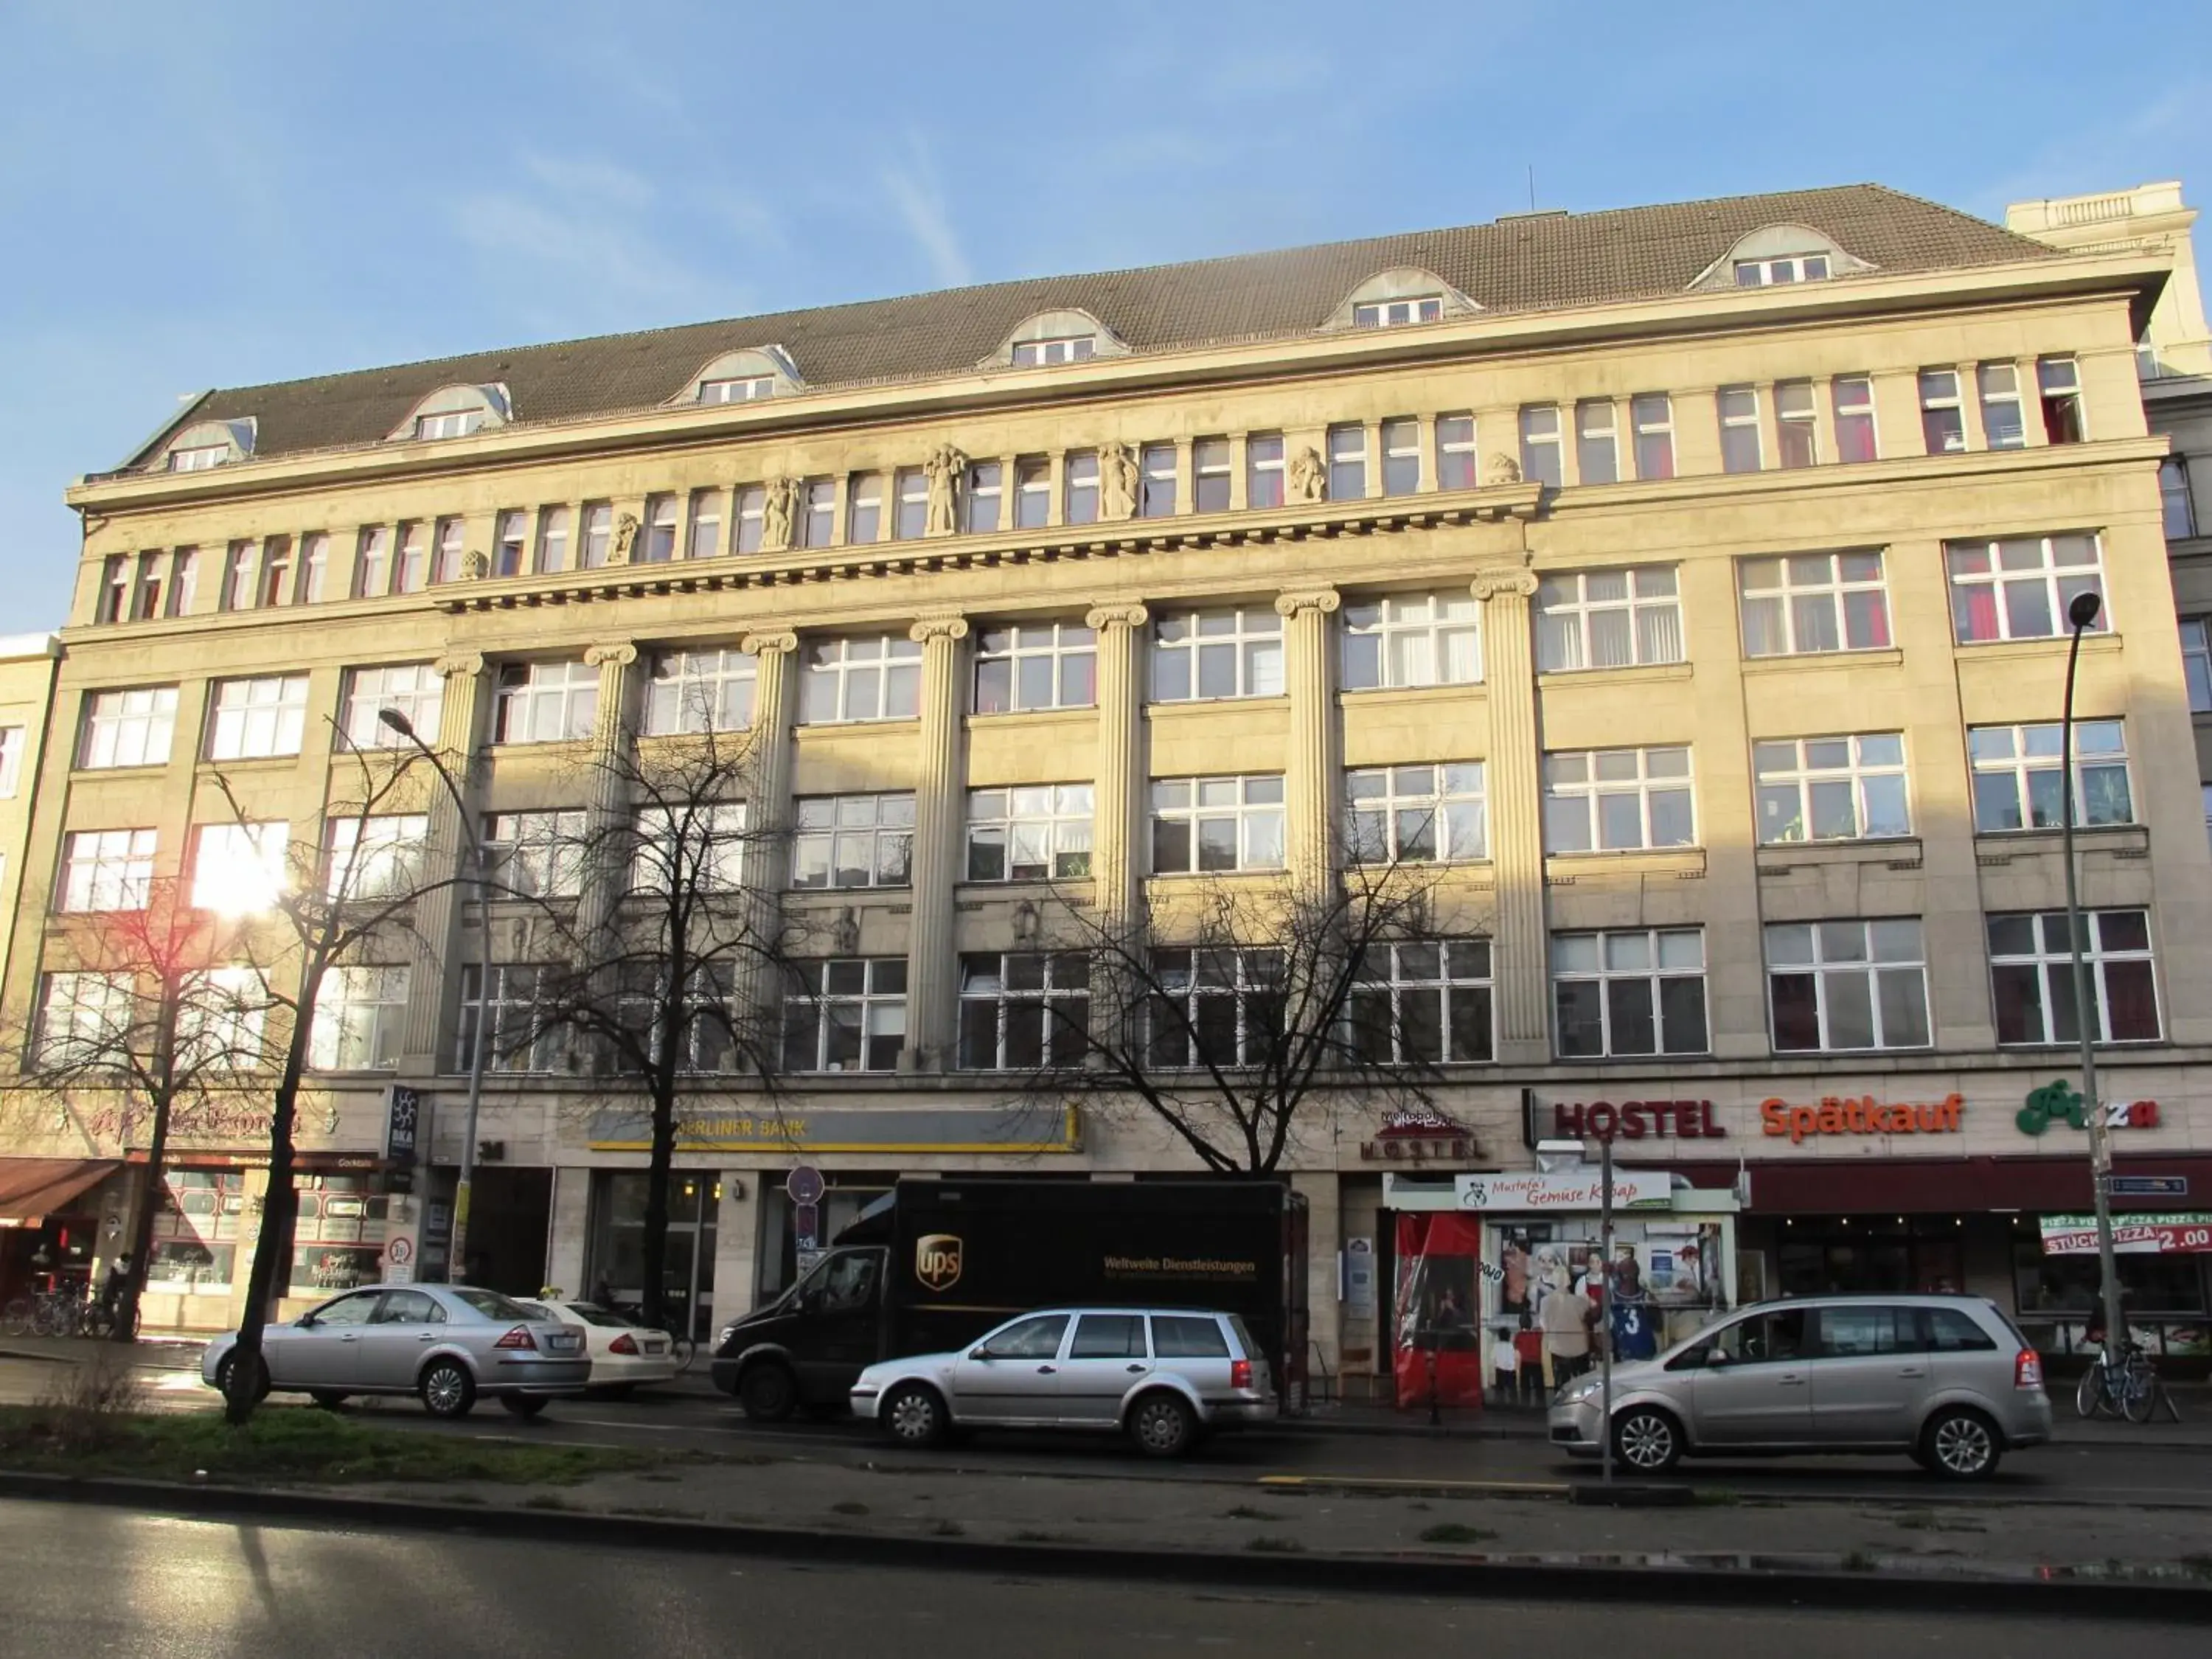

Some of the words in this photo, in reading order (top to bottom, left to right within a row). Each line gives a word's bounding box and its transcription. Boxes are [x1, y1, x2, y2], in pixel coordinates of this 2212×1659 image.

[1760, 1093, 1964, 1144] Spätkauf
[2015, 1079, 2162, 1135] Piza
[759, 1119, 806, 1137] BANK
[1554, 1100, 1728, 1141] HOSTEL
[1360, 1138, 1489, 1162] HOSTEL
[1526, 1186, 1585, 1206] Gemüse
[1589, 1180, 1638, 1202] Kbap
[2118, 1215, 2154, 1226] PIZZA
[2157, 1214, 2196, 1225] PIZZA
[919, 1251, 959, 1282] ups
[1104, 1256, 1160, 1270] Weltweite
[1163, 1257, 1256, 1274] Dienstleistungen
